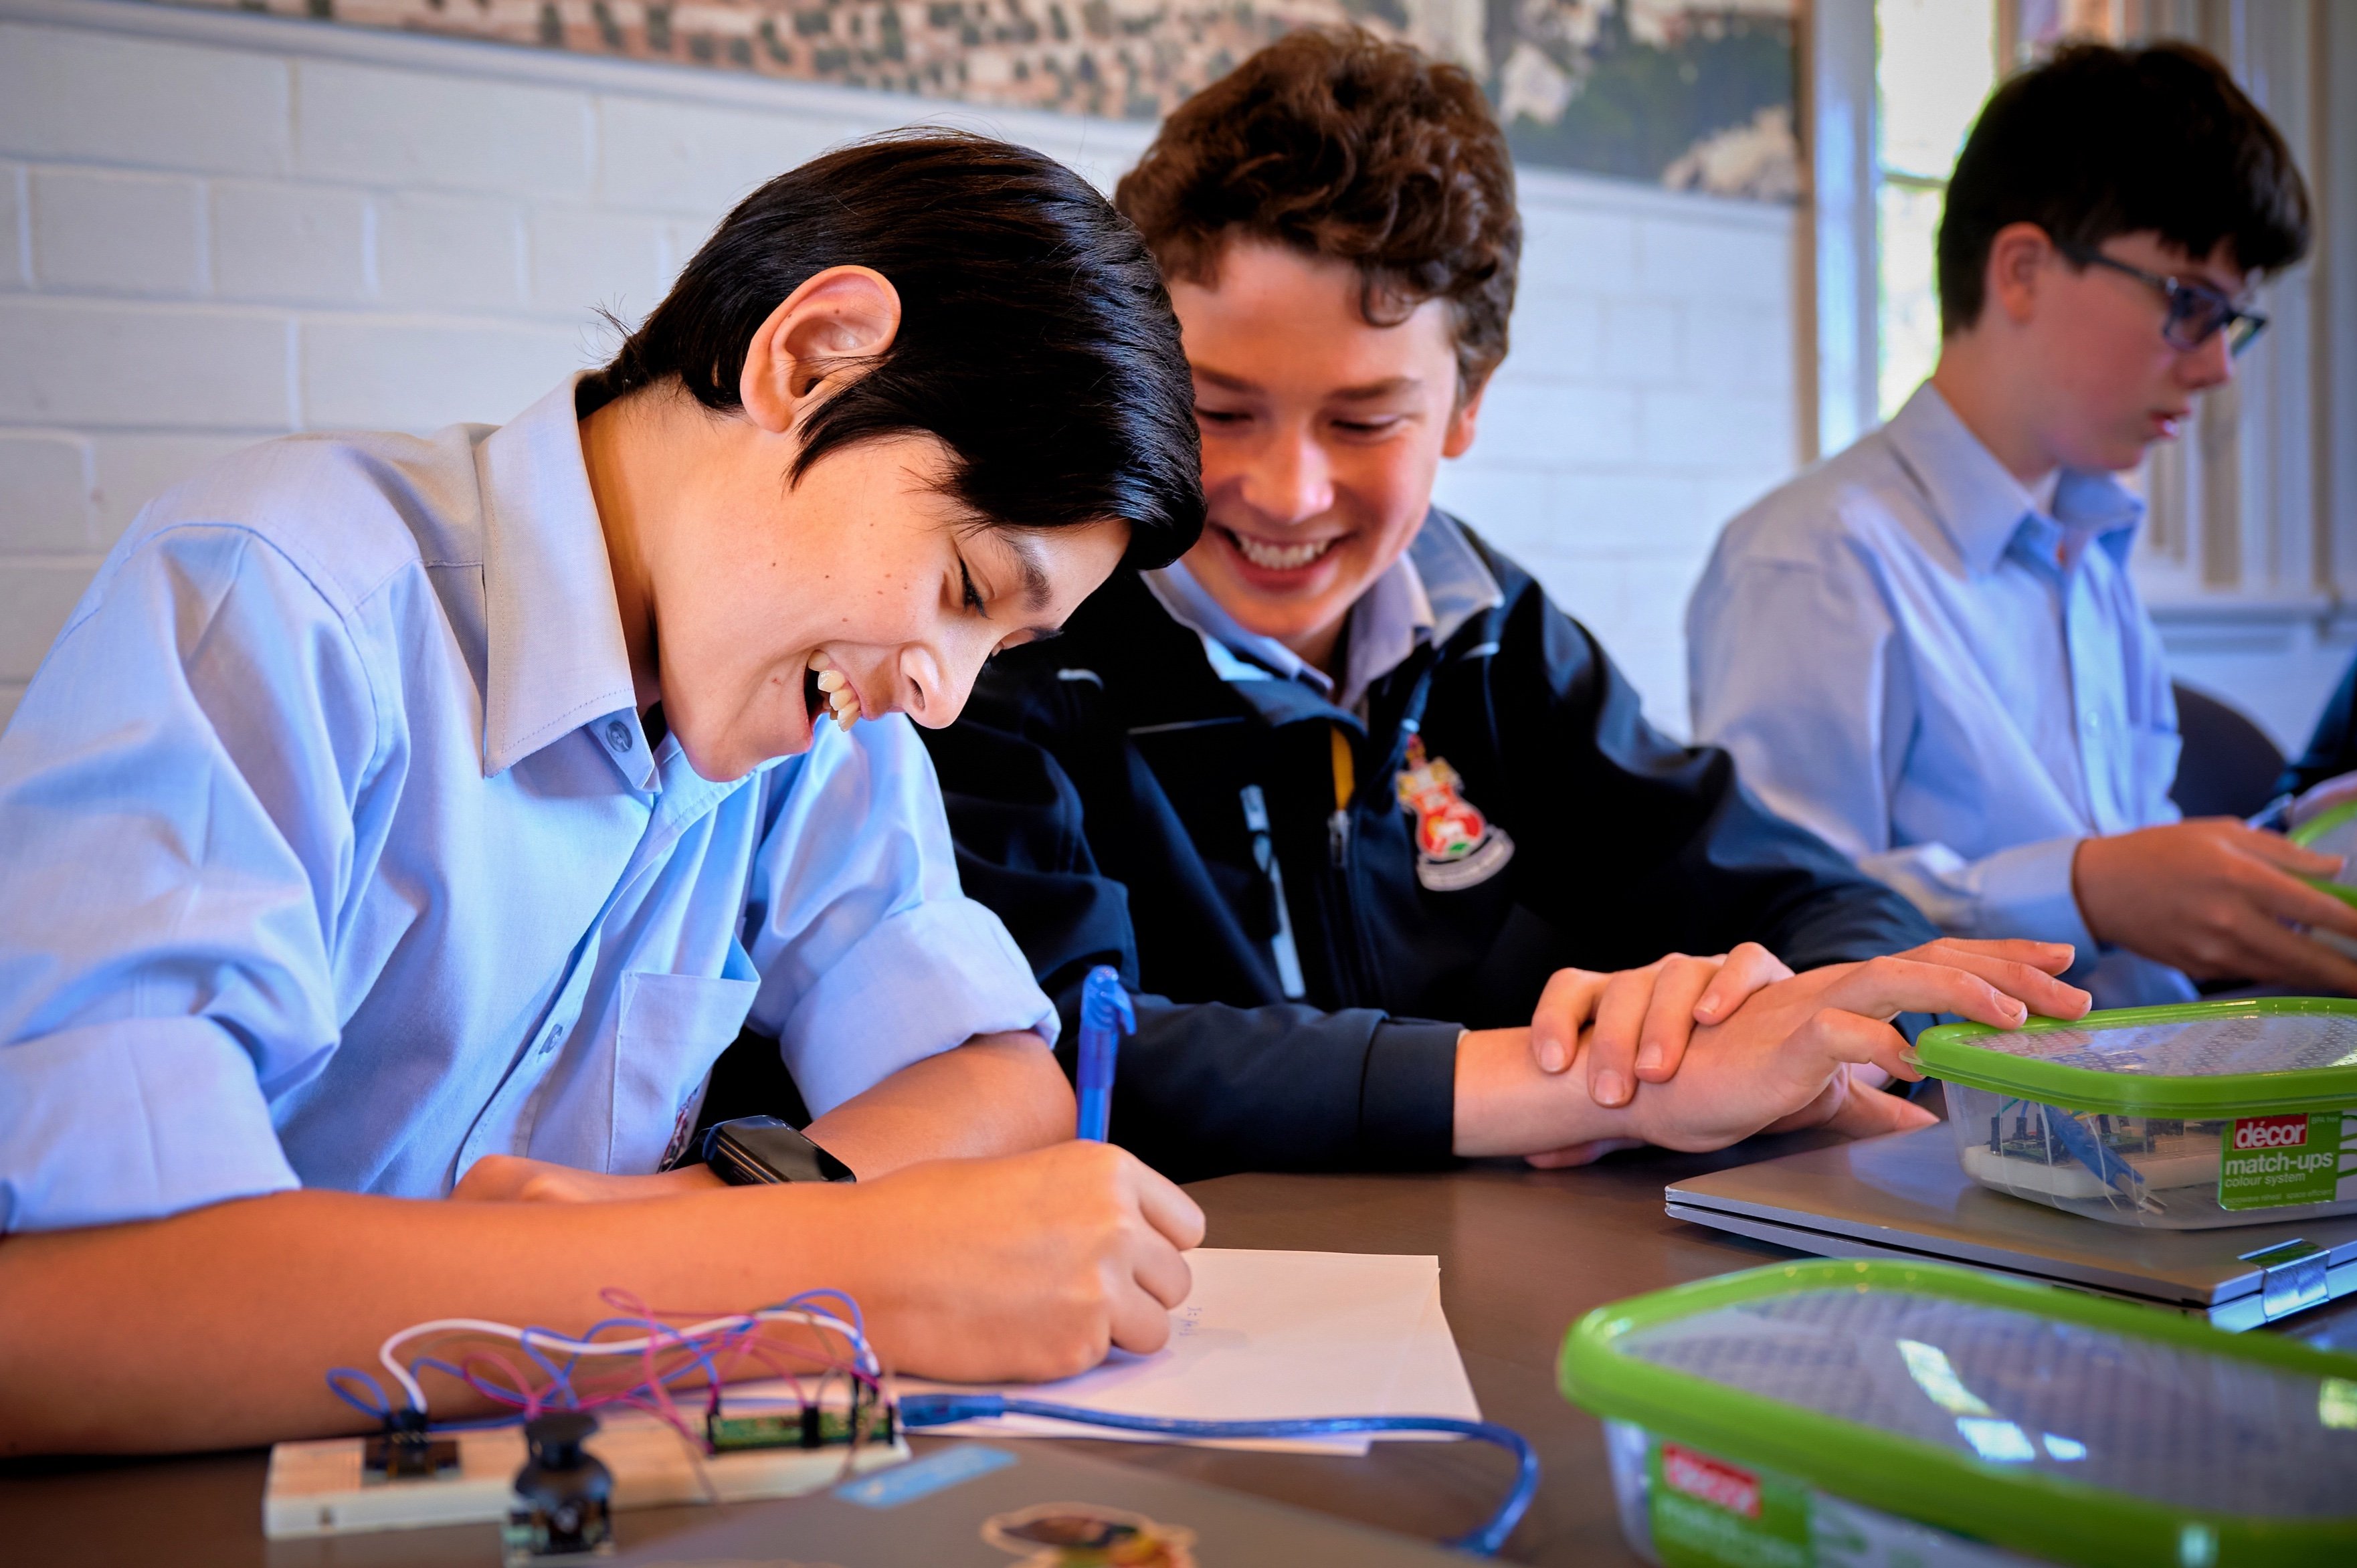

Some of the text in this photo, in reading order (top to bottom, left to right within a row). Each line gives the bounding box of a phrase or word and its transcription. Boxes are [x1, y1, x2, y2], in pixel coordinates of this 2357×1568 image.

[2236, 1121, 2305, 1149] décor
[2226, 1151, 2334, 1175] match-ups
[2225, 1173, 2305, 1188] colour system
